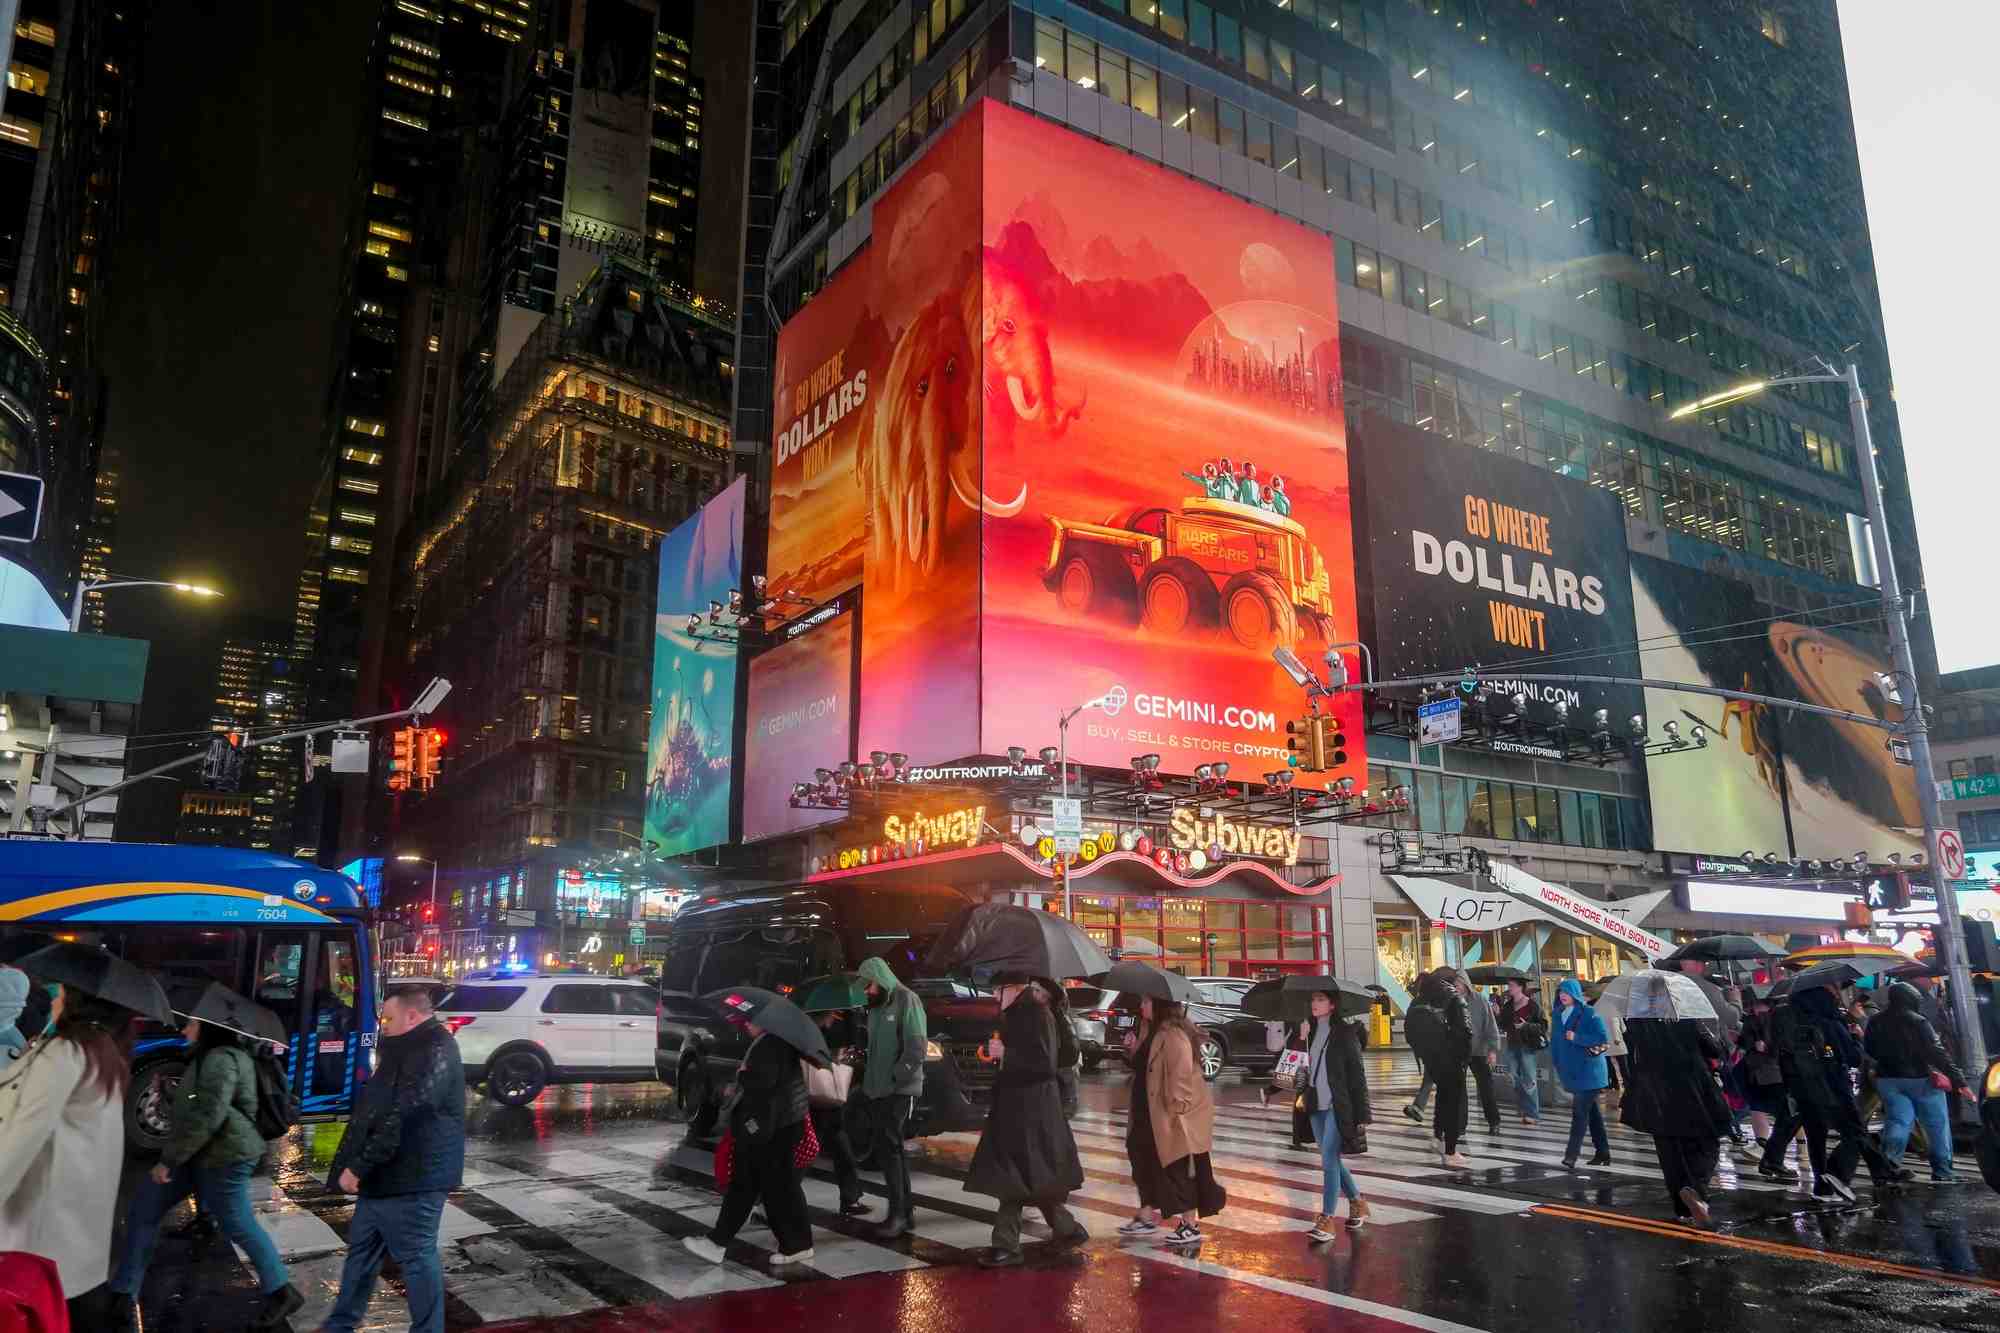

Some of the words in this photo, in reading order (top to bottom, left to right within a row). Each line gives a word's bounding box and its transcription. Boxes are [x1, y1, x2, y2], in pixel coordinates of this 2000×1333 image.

[777, 369, 867, 467] DOLLARS
[1180, 529, 1218, 544] MARS
[1464, 494, 1490, 539] GO
[1491, 501, 1553, 556] WHERE
[1191, 542, 1249, 562] SAFARIS
[1412, 529, 1606, 616] DOLLARS
[1487, 600, 1545, 651] WON'T
[768, 695, 837, 735] GEMINI.COM
[1133, 693, 1276, 732] GEMINI.COM
[1087, 724, 1124, 745] BUY,
[1127, 729, 1165, 745] SELL
[1168, 735, 1179, 747] &
[1182, 736, 1231, 753] STORE
[1233, 742, 1291, 761] CRYPTO
[1494, 741, 1563, 759] #OUTFRONTPRIME
[1956, 781, 1967, 797] W
[1969, 779, 1985, 794] 42
[884, 805, 987, 848] Subway
[1170, 807, 1301, 866] Subway
[257, 908, 288, 920] 7604
[1440, 896, 1512, 922] LOFT
[1540, 887, 1572, 910] NORTH
[1573, 902, 1602, 924] SHORE
[1603, 916, 1628, 937] NEON
[1628, 930, 1647, 947] SIGN
